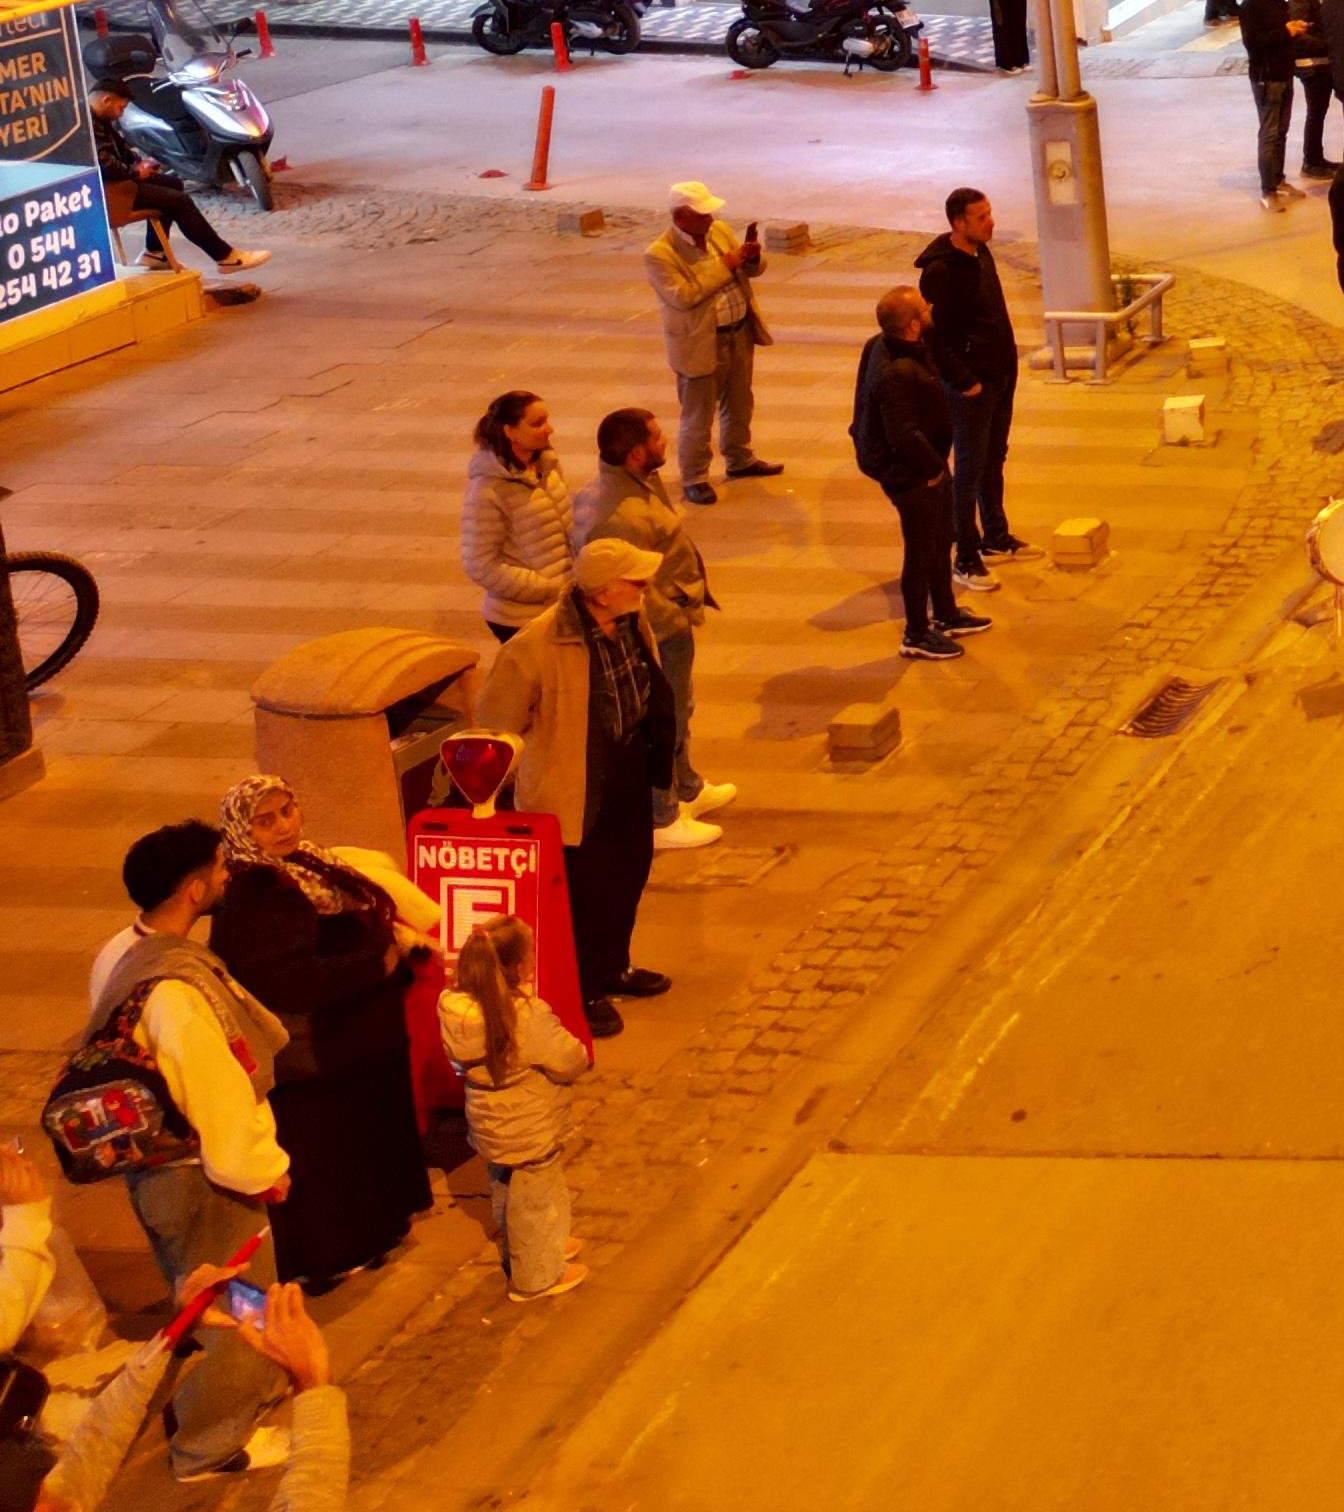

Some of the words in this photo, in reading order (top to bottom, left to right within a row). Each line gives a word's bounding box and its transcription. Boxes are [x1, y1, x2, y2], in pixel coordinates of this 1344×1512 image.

[24, 184, 93, 228] Paket
[8, 243, 25, 271] 0
[30, 225, 76, 263] 544
[0, 272, 37, 309] 254
[42, 259, 73, 290] 42
[77, 250, 101, 280] 31
[418, 840, 537, 879] NÖBETÇİ
